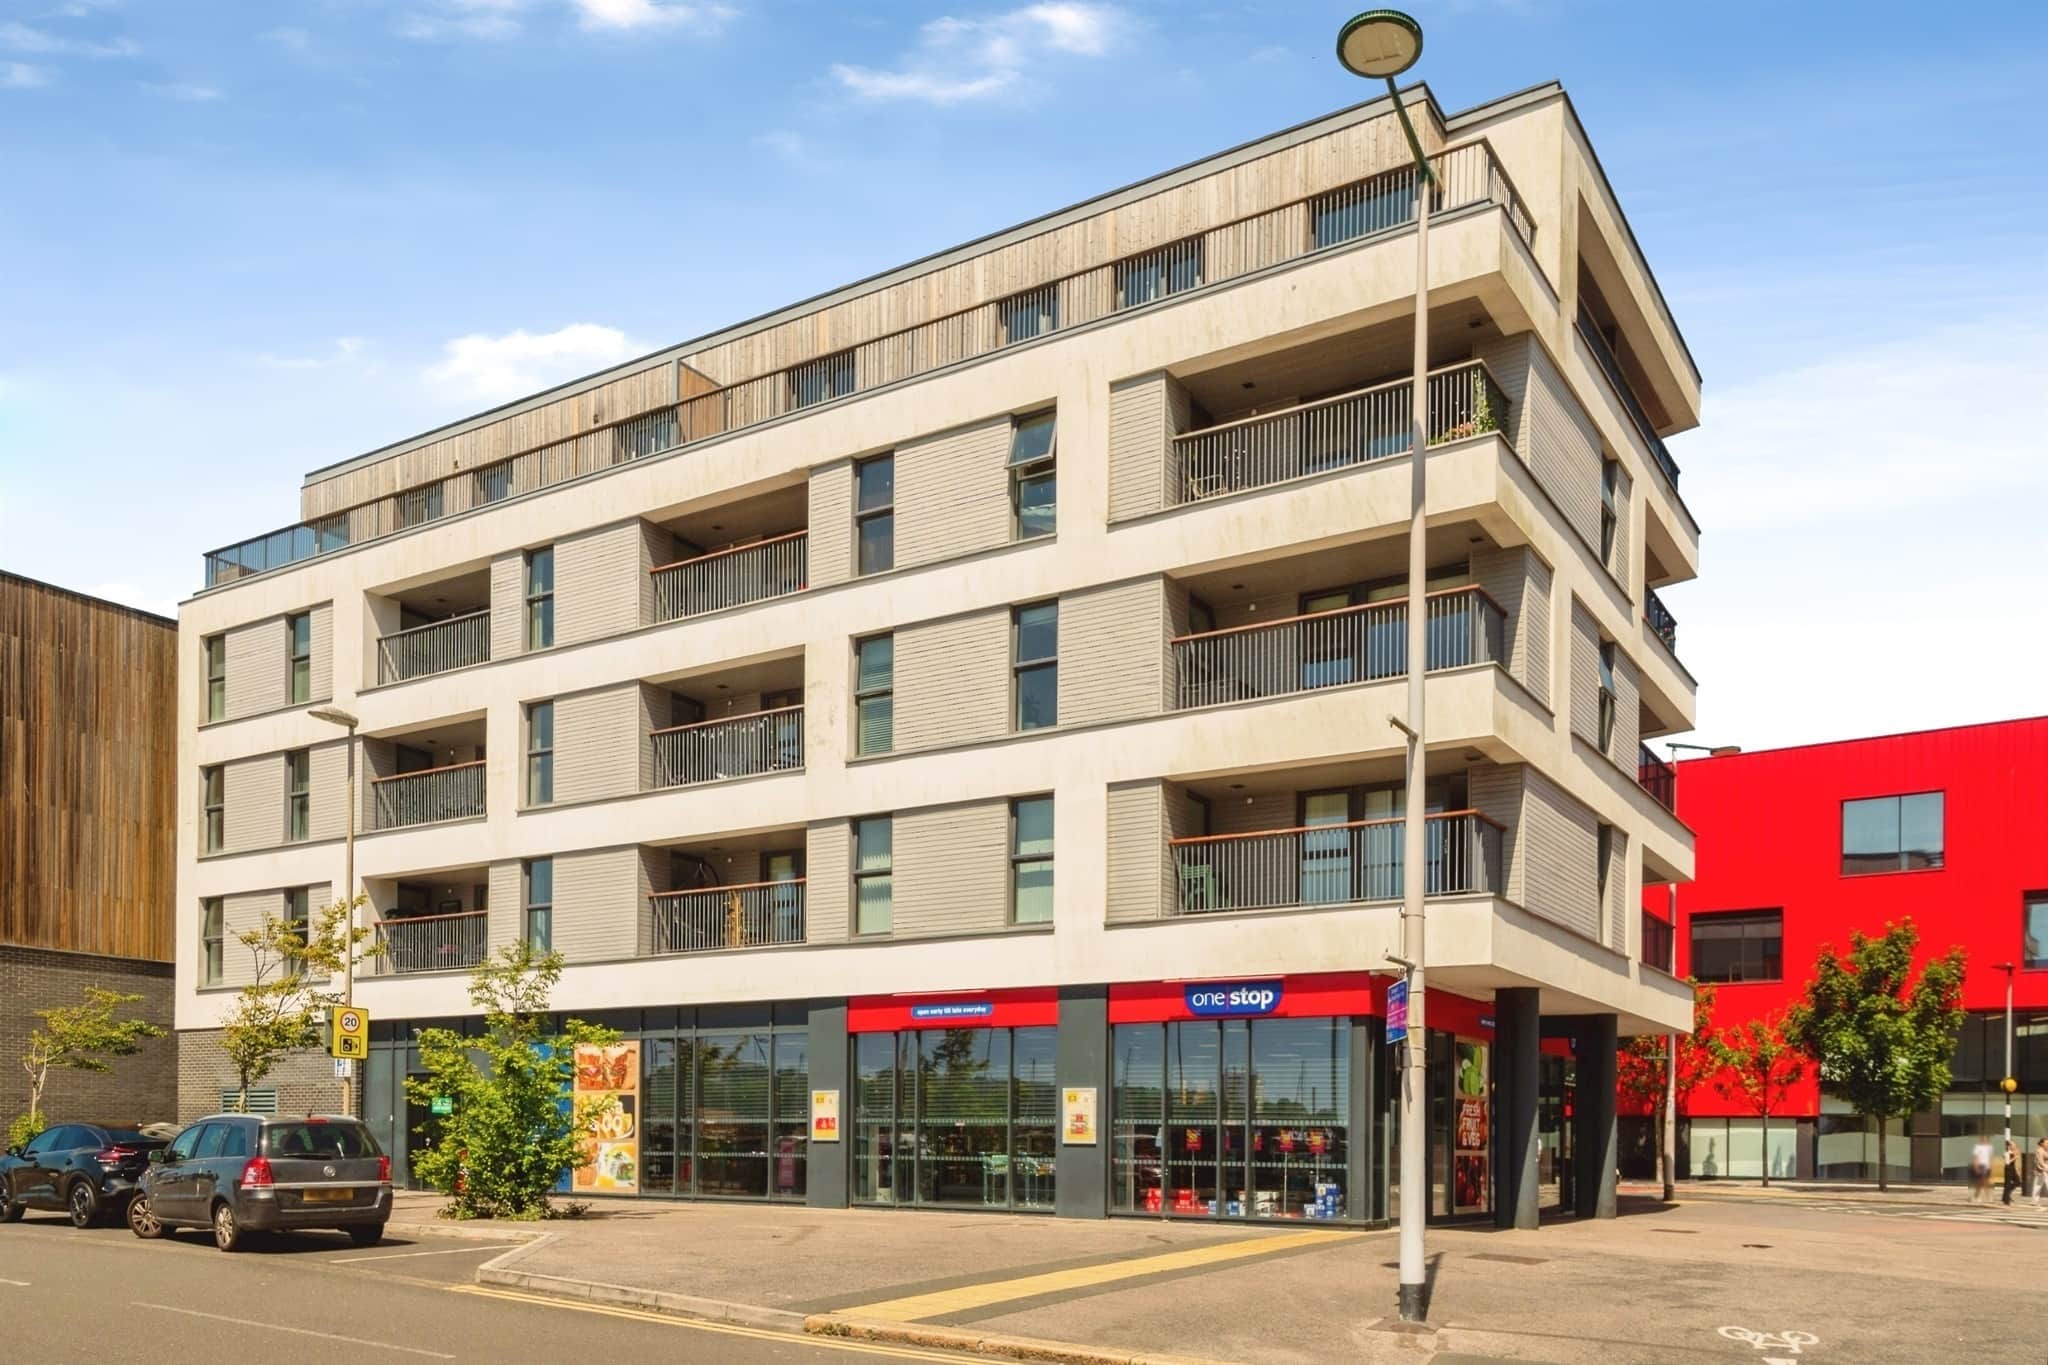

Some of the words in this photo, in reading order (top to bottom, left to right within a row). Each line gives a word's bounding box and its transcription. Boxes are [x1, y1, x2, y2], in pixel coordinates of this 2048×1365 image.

[1192, 992, 1225, 1006] one
[1230, 987, 1274, 1010] stop
[344, 1017, 357, 1027] 20
[1463, 1104, 1481, 1117] FRESH
[1462, 1117, 1481, 1130] FRUIT
